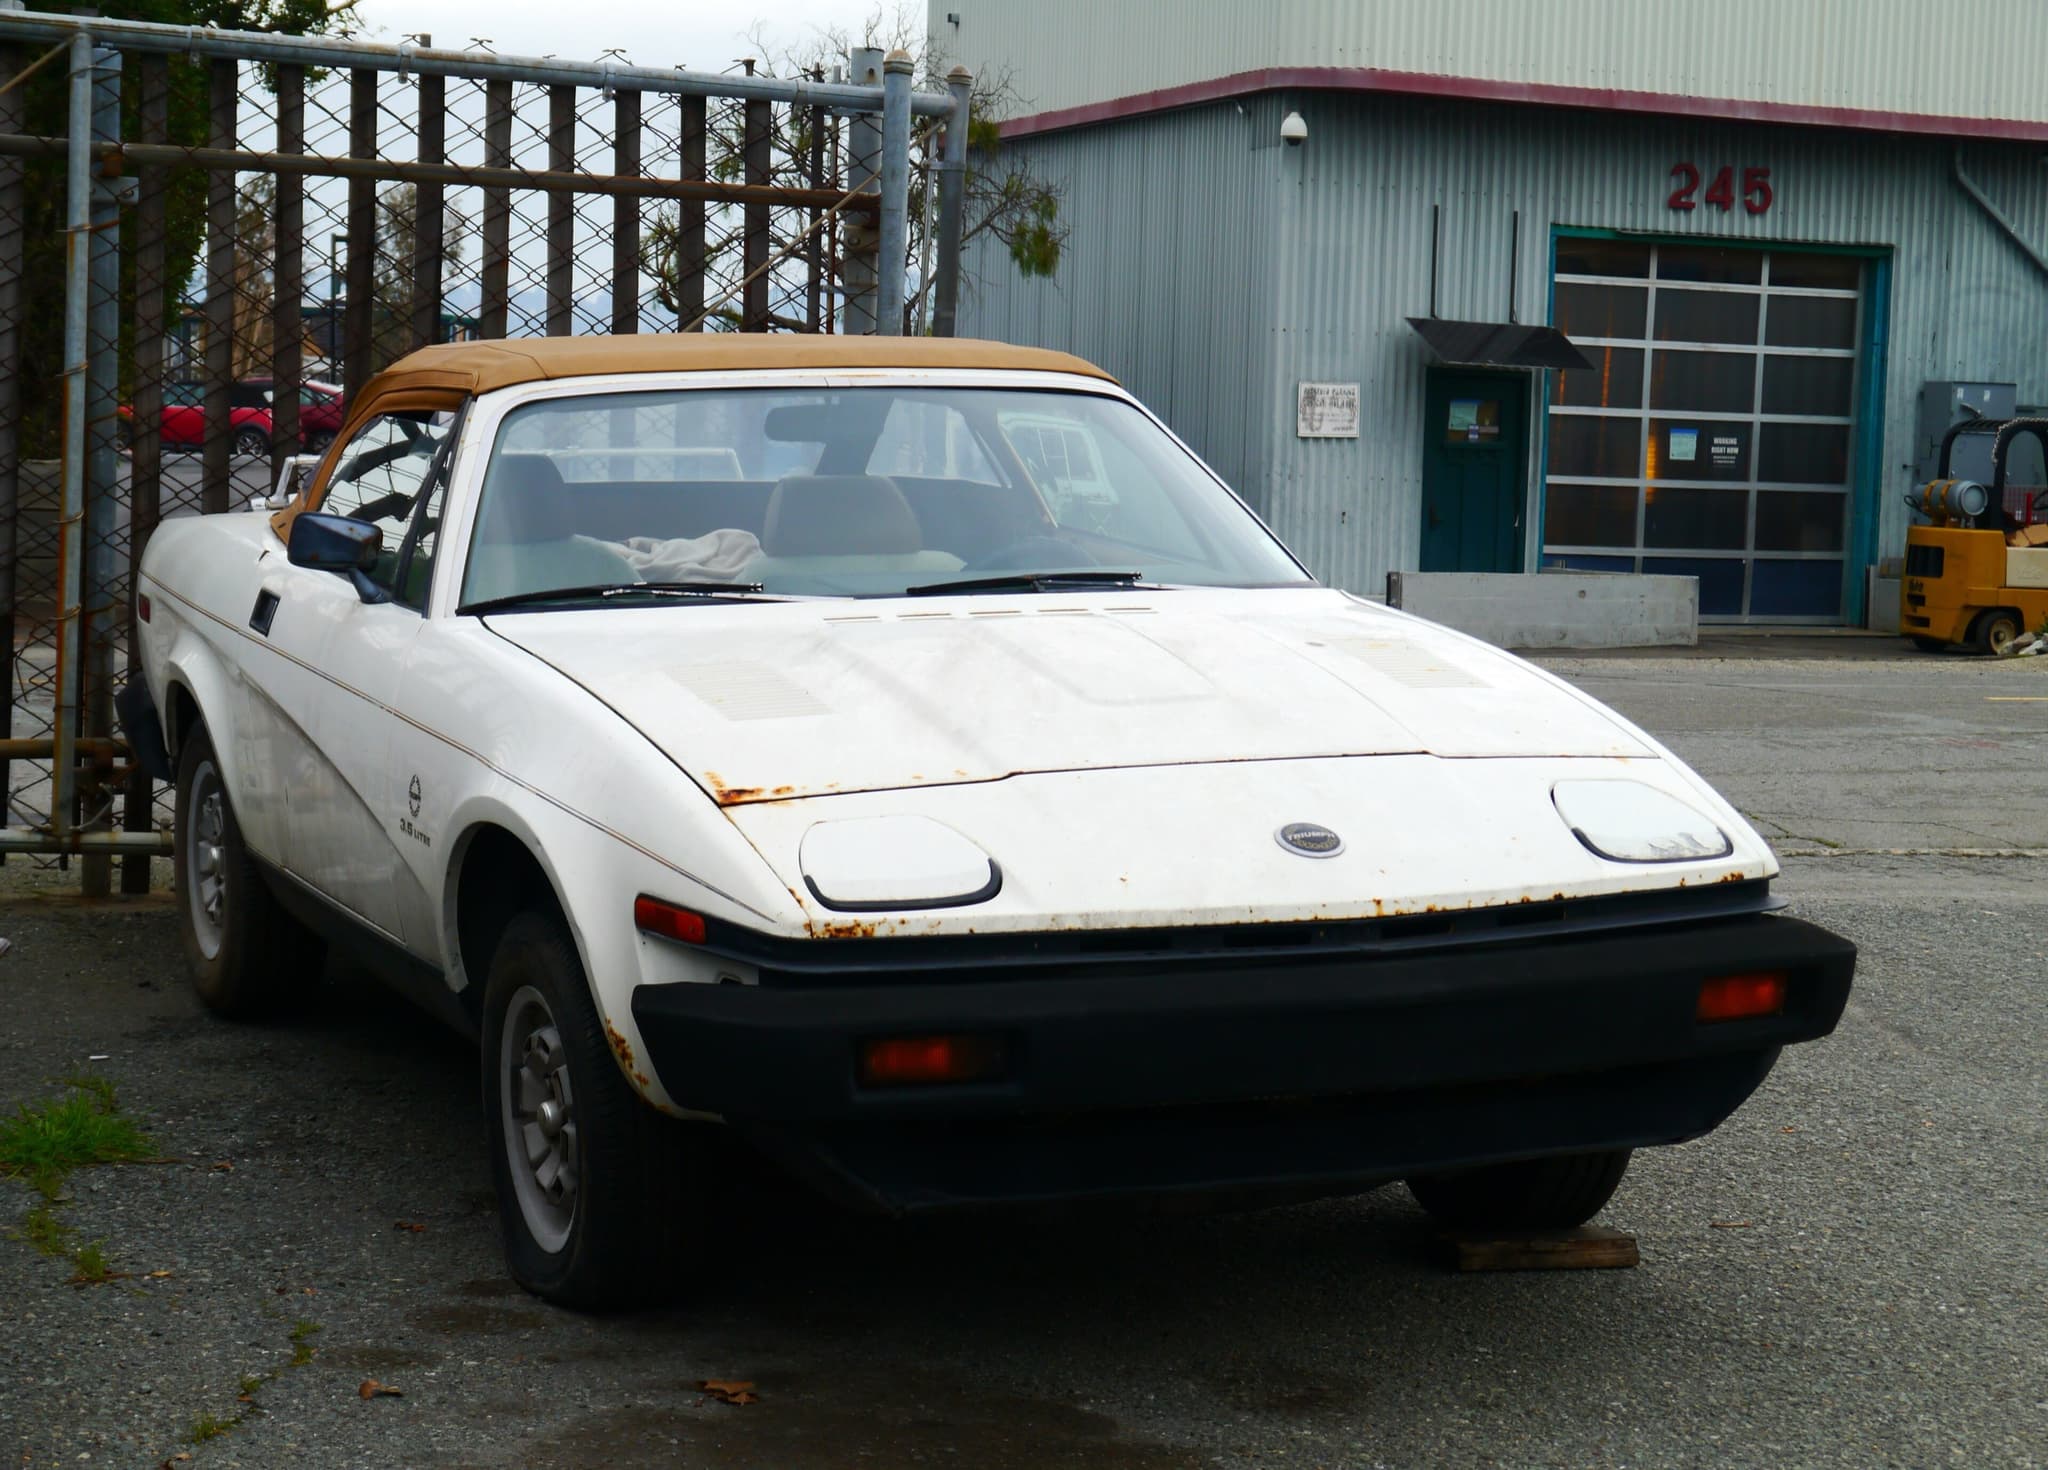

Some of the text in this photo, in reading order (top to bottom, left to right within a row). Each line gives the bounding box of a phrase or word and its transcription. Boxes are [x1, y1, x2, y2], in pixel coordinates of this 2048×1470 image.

[1667, 163, 1773, 214] 245
[1727, 447, 1739, 455] NOW
[400, 817, 431, 848] 3.5 LITRE
[1287, 831, 1336, 841] TRIUMPH
